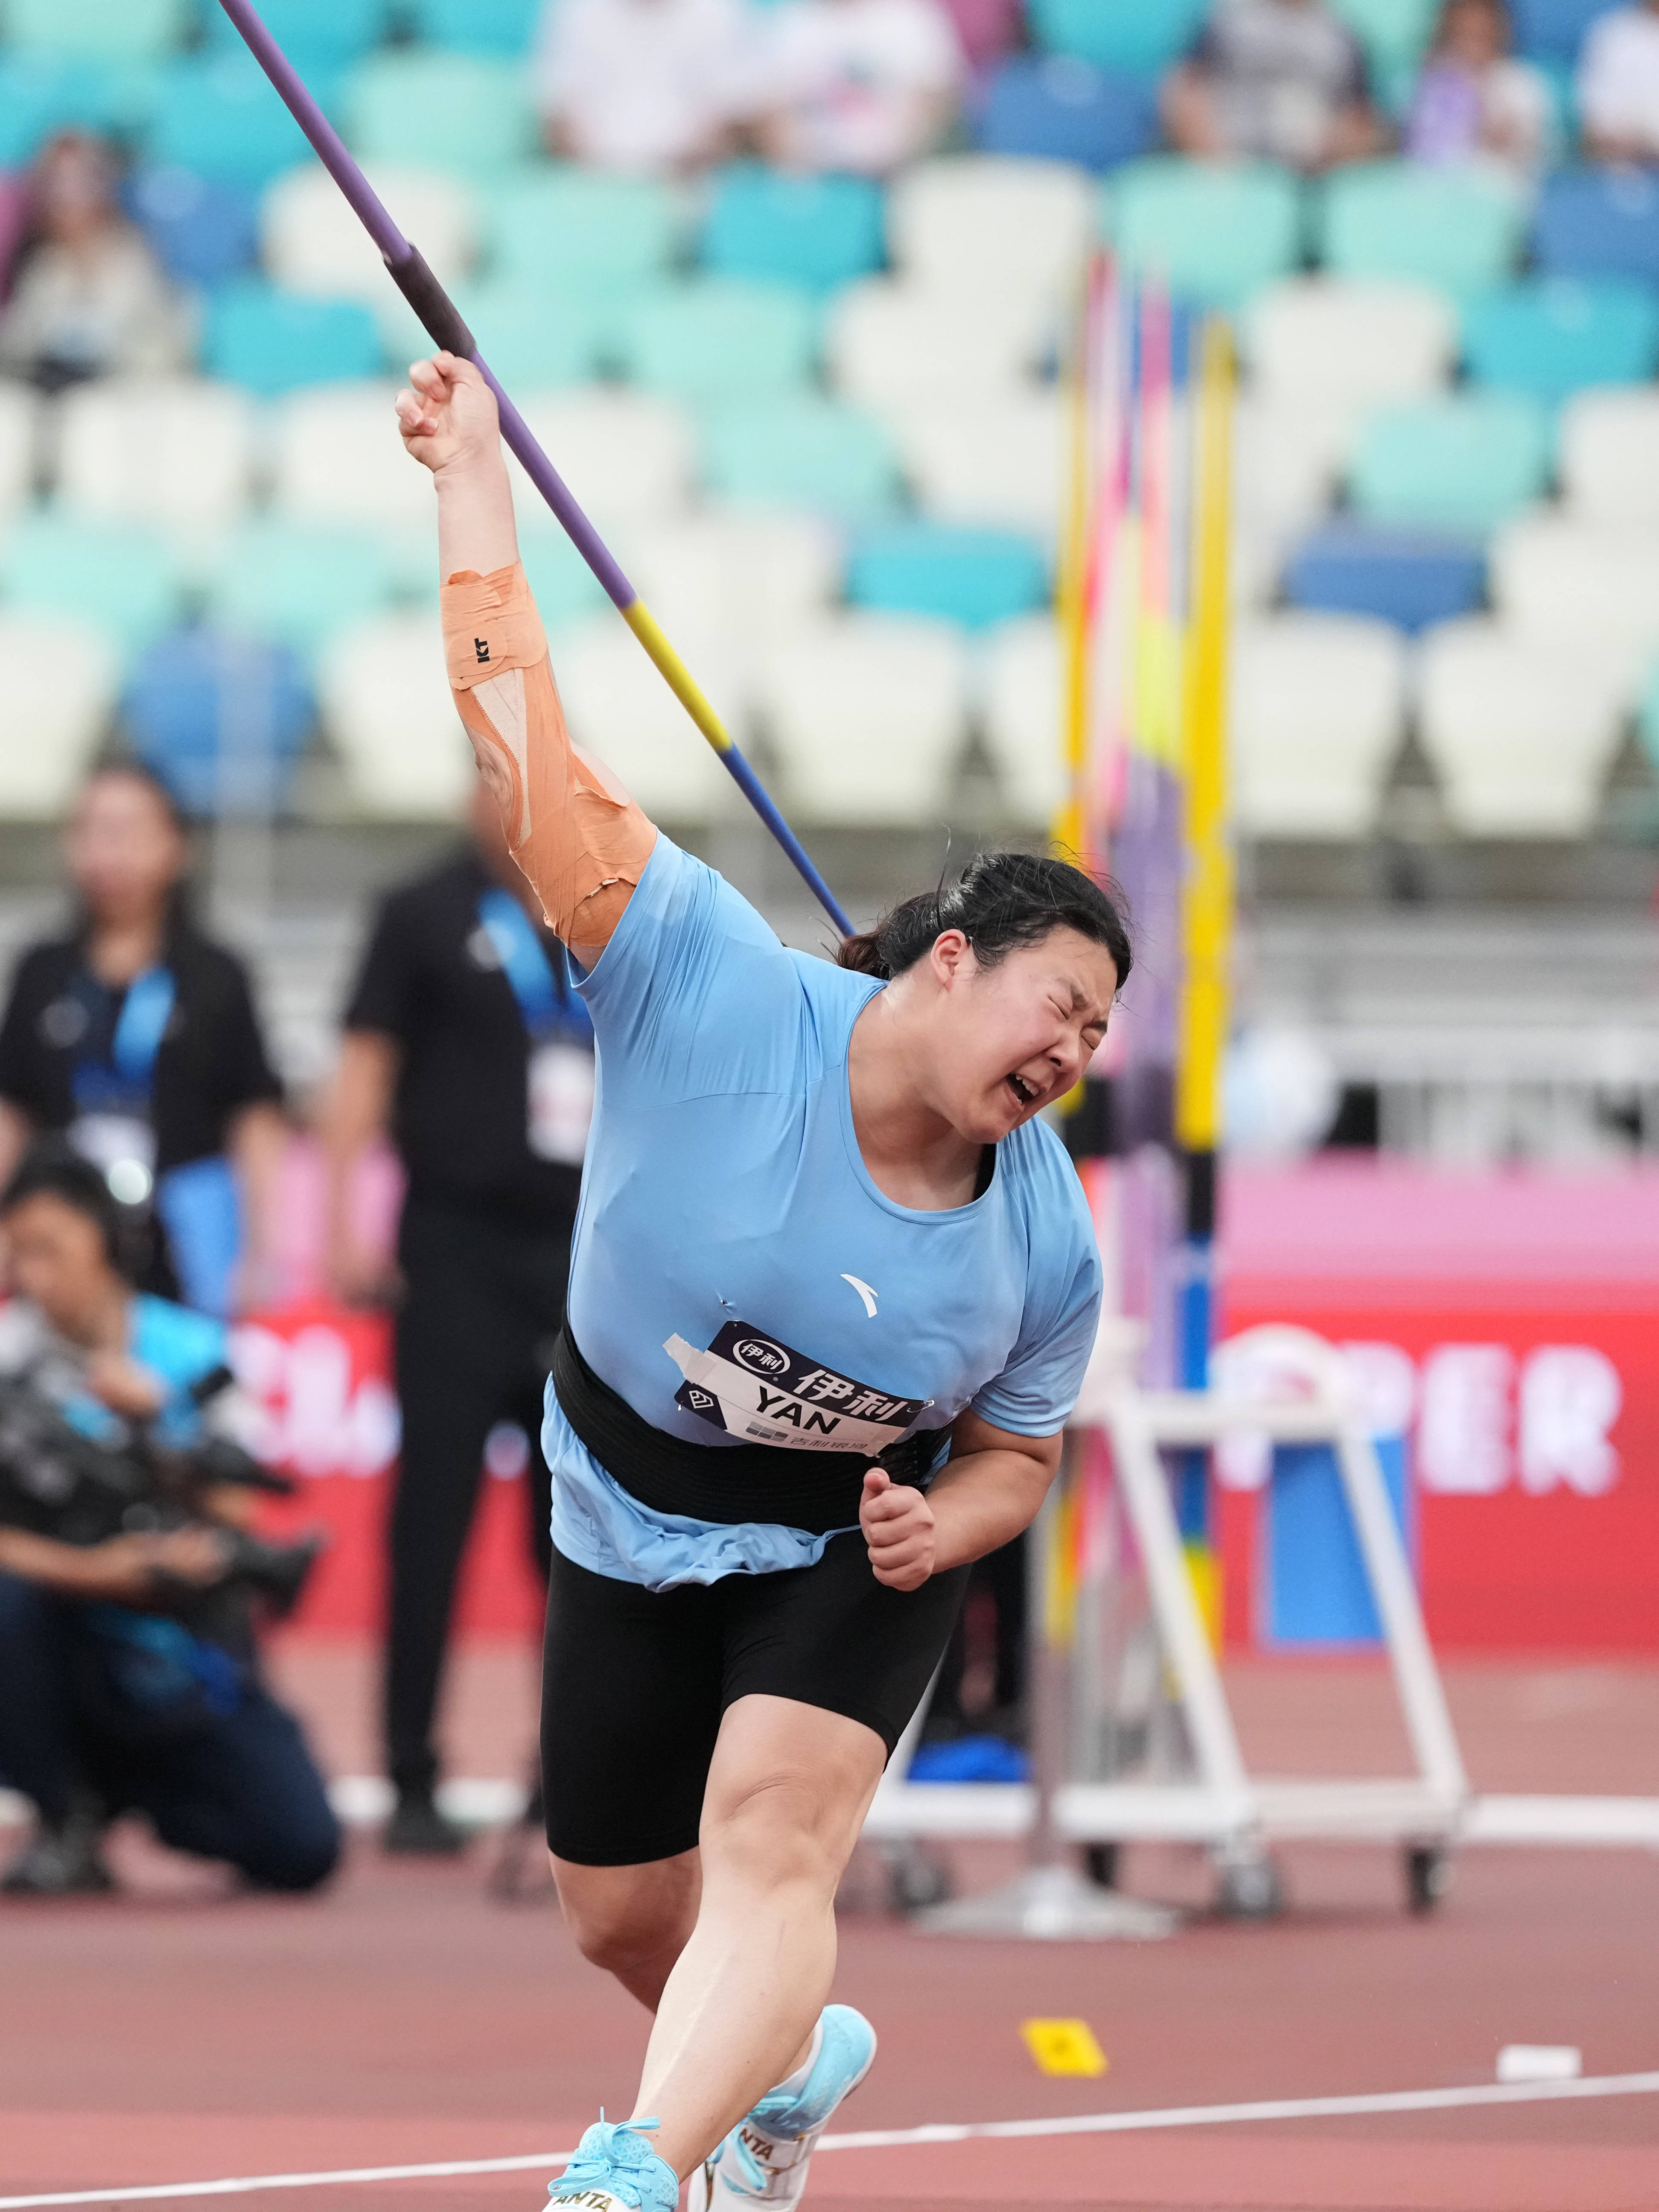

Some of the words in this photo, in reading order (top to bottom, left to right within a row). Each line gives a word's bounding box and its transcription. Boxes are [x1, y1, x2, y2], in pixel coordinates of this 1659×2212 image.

[741, 1343, 783, 1370] 伊利
[756, 1386, 842, 1435] YAN
[793, 1369, 908, 1421] 伊利
[790, 1437, 868, 1449] 吉利银河
[740, 2127, 774, 2160] NTA
